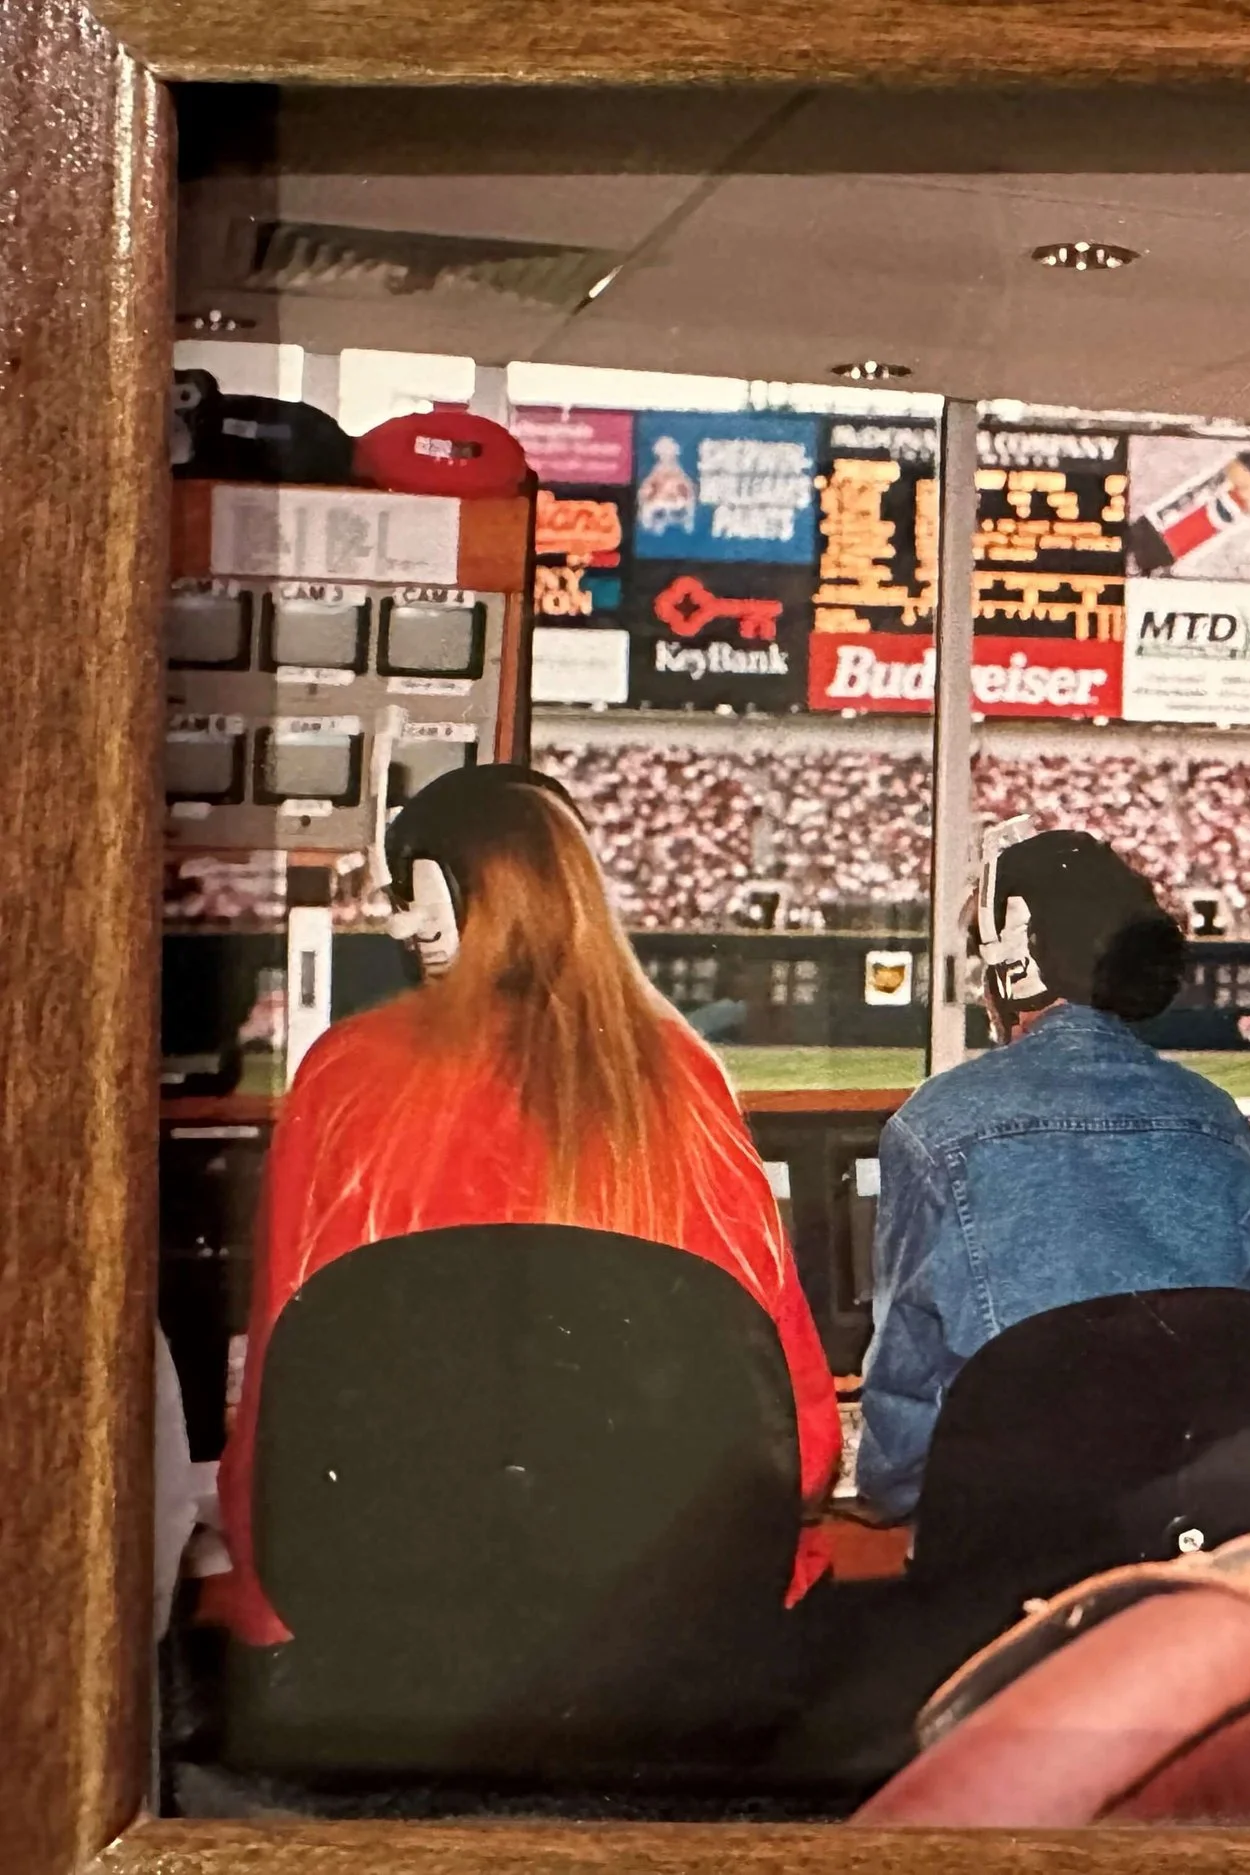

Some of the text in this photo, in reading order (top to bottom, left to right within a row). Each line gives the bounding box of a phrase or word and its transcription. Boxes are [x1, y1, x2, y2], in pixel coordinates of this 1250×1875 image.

[1140, 611, 1237, 642] MTD
[655, 640, 789, 681] KeyBank
[825, 645, 1107, 706] Budeiser
